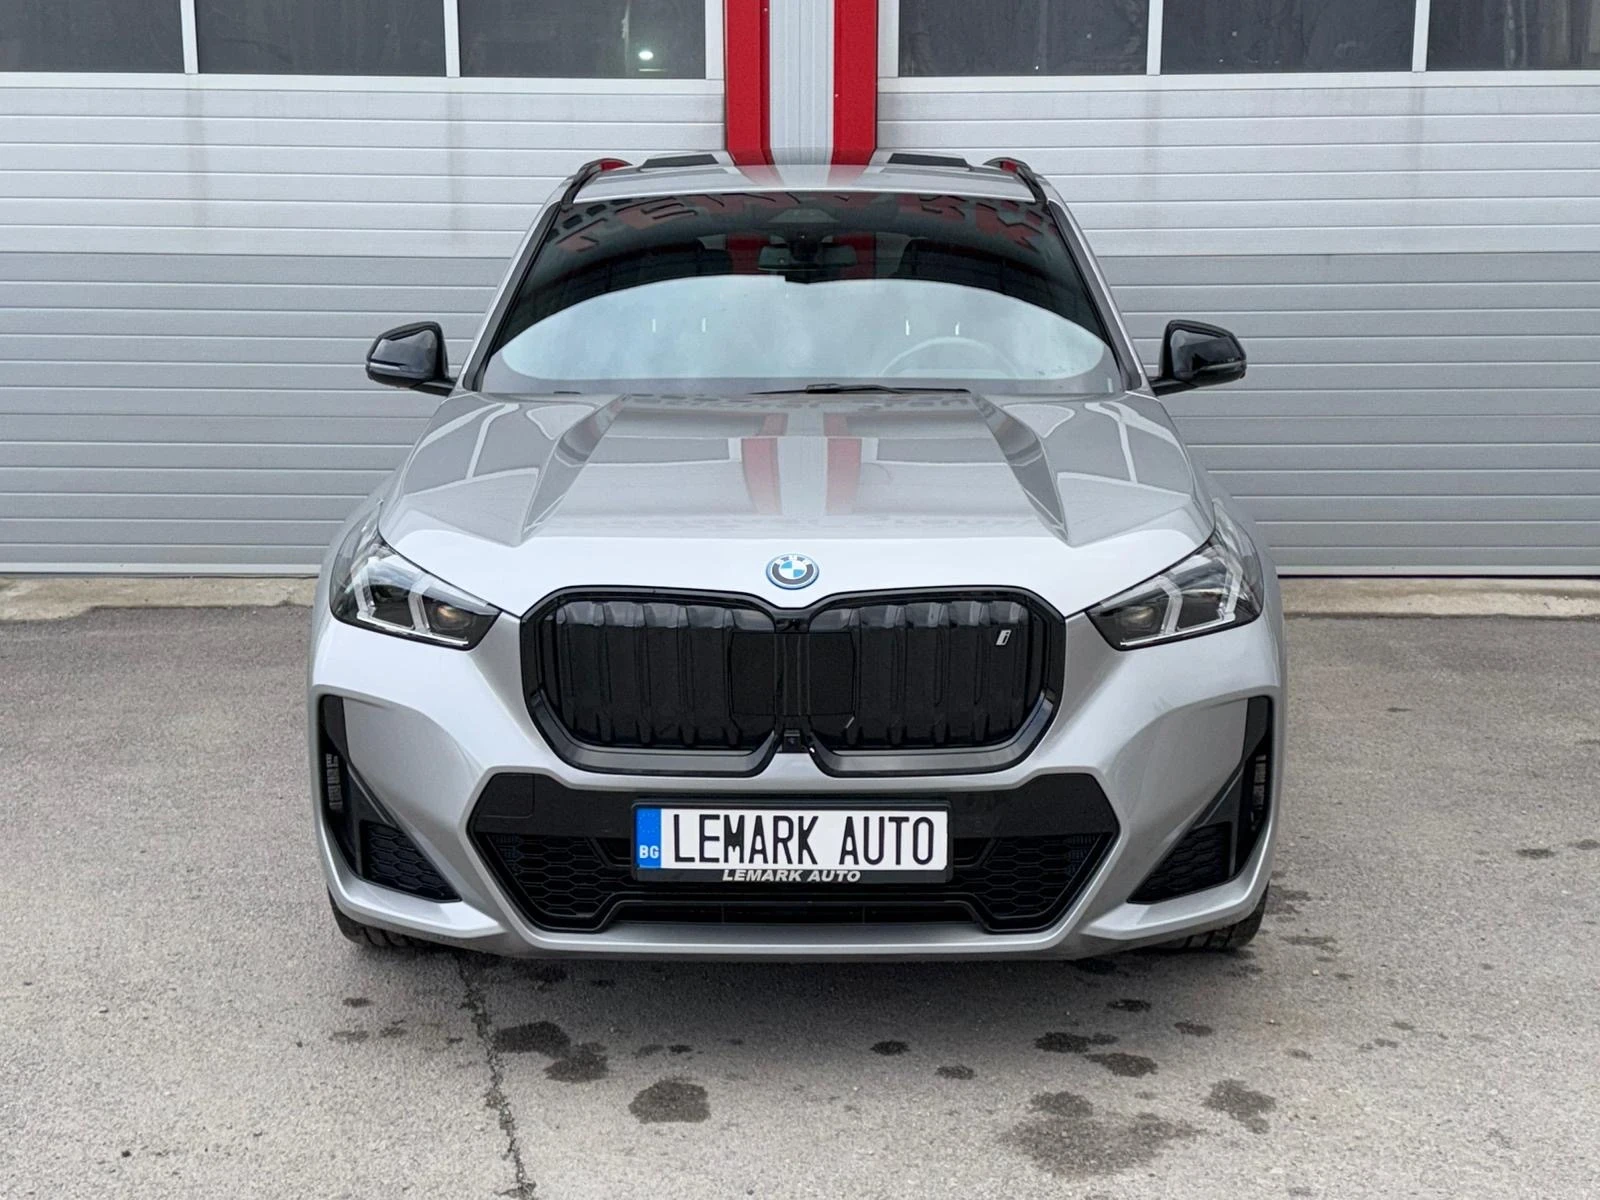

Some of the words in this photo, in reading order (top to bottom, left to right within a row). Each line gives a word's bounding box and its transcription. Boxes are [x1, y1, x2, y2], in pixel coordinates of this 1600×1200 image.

[673, 813, 820, 866] LEMARK
[839, 815, 935, 866] AUTO
[639, 845, 660, 859] BG
[722, 869, 803, 882] LEMARK
[806, 870, 861, 883] AUTO
